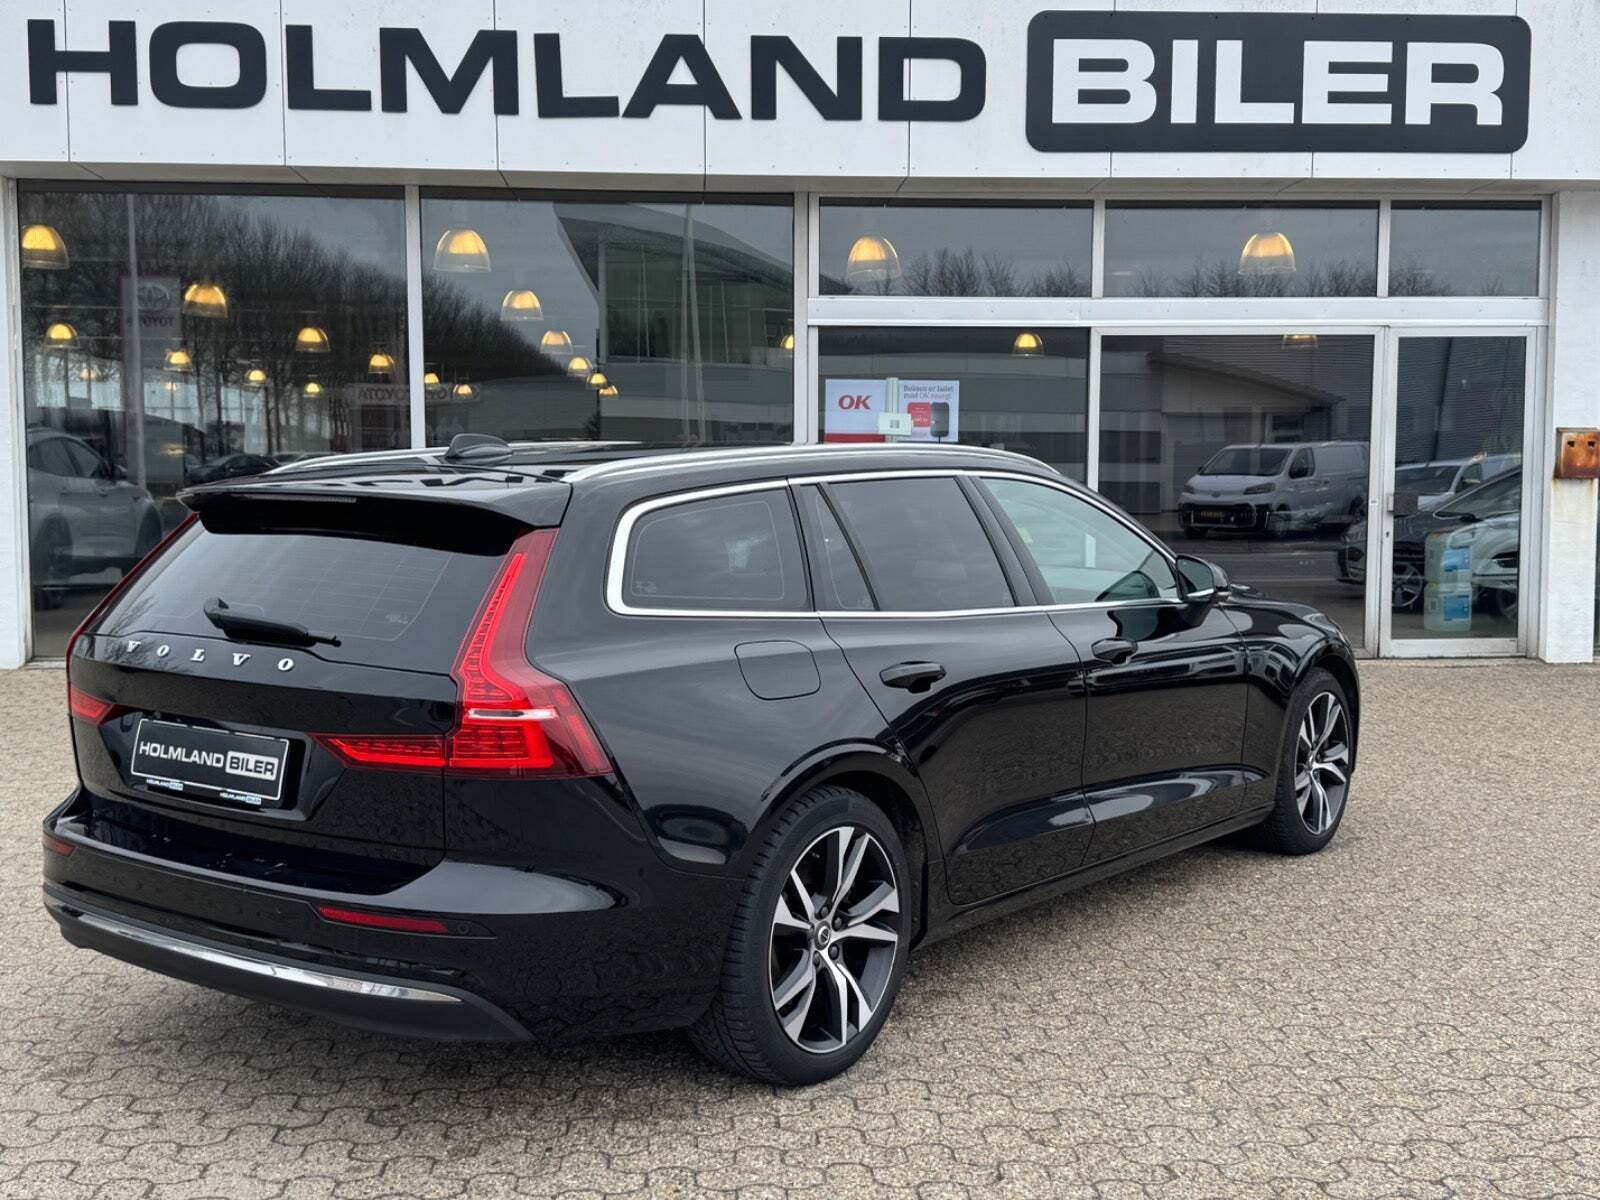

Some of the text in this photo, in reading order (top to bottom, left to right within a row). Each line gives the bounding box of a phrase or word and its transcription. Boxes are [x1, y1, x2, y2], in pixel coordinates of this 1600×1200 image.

[29, 18, 1506, 127] HOLMLAND BILER
[838, 394, 872, 411] OK
[127, 640, 295, 672] VOLVO
[139, 740, 276, 776] HOLMLAND BILER
